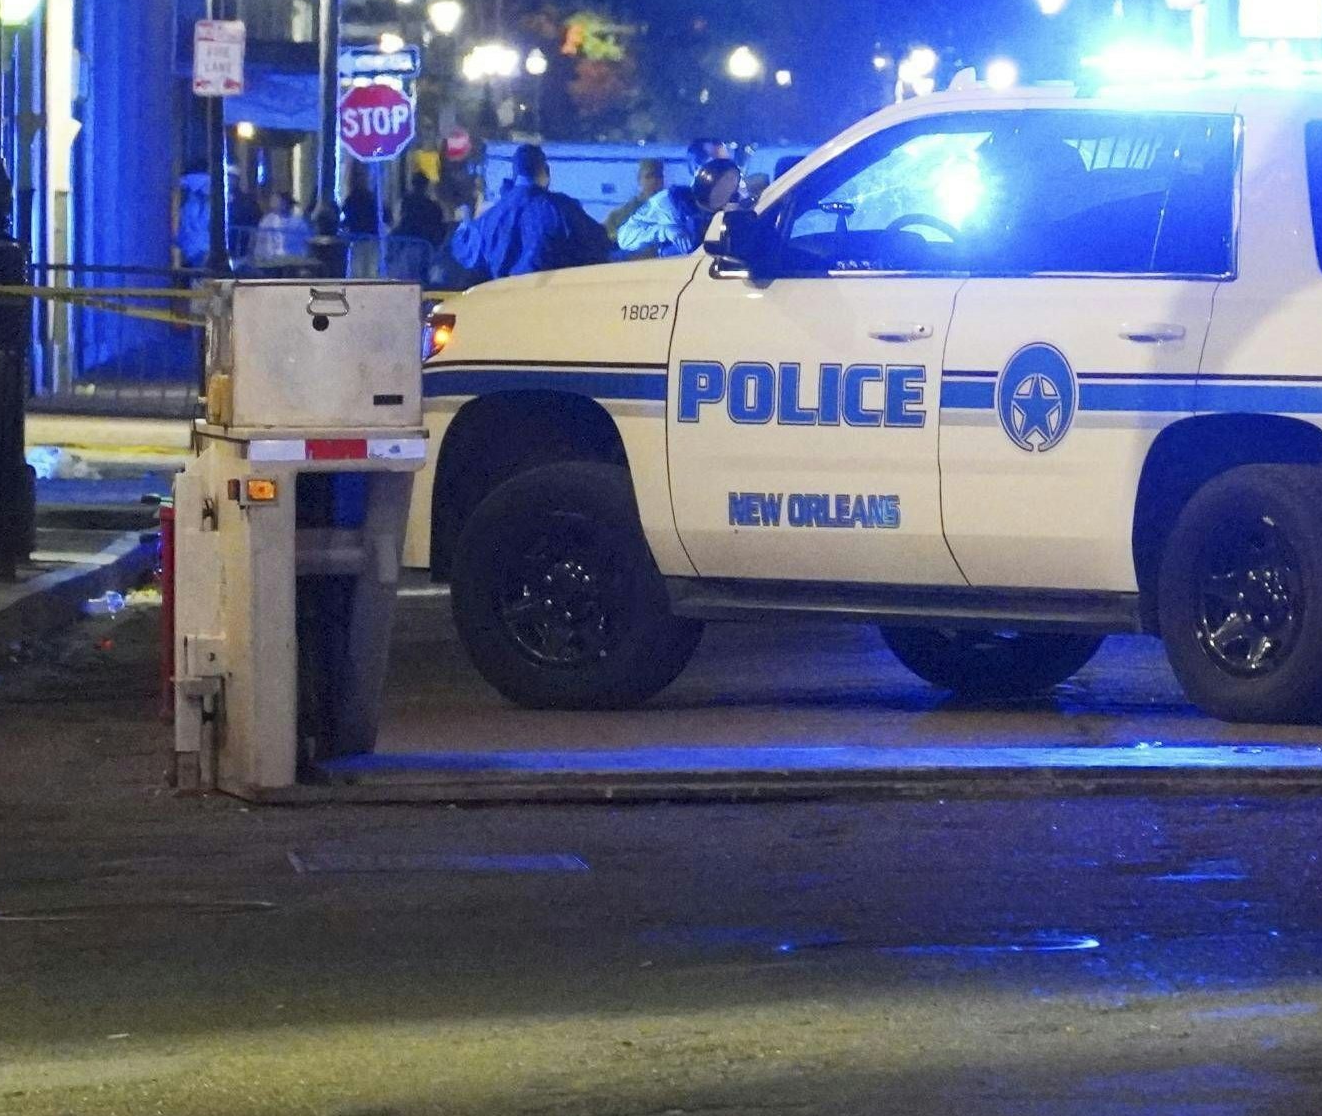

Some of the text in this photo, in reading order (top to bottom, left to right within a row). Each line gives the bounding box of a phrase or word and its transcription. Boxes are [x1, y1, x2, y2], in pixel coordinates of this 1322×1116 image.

[342, 105, 409, 138] STOP
[621, 304, 670, 321] 18027
[677, 359, 927, 428] POLICE
[728, 491, 902, 530] NEW ORLEANS
